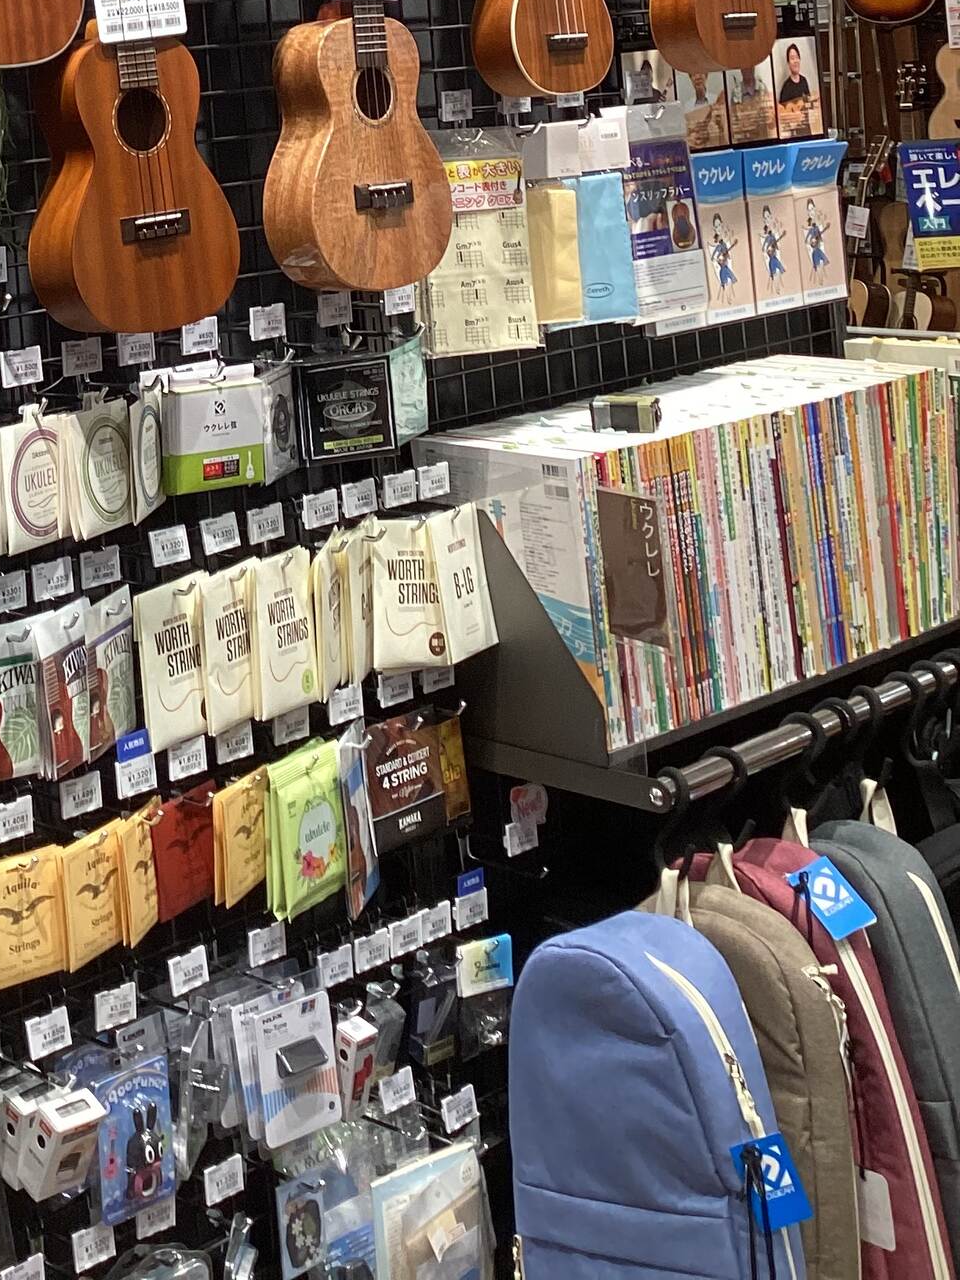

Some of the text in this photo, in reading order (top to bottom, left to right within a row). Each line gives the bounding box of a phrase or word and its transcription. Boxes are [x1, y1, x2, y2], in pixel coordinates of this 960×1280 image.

[752, 159, 786, 178] ウクレレ
[802, 153, 836, 172] ウクレレ
[699, 166, 736, 185] ウクレレ
[24, 468, 57, 493] UKULEL
[639, 502, 661, 578] ウクレレ
[387, 559, 425, 581] WORTH
[267, 596, 296, 626] WORTH
[216, 608, 248, 641] WORTH
[277, 617, 308, 649] STRINGS
[154, 622, 190, 656] WORTH
[390, 762, 428, 787] STRING
[9, 939, 40, 956] Strings
